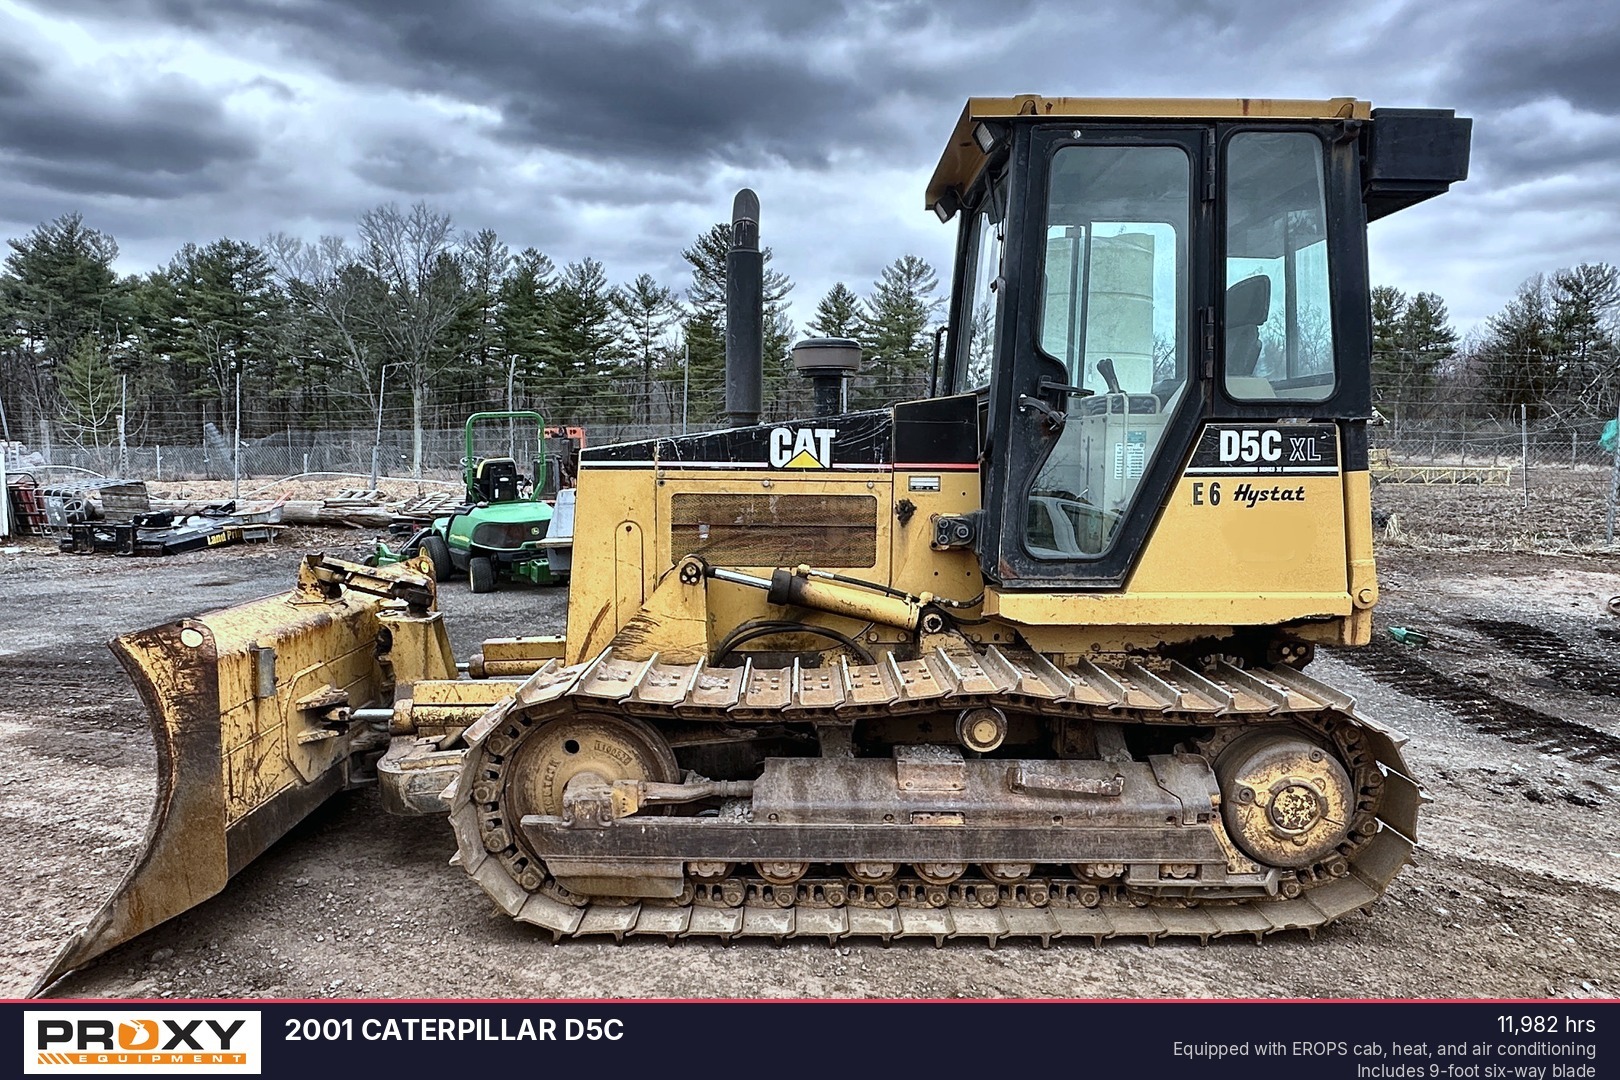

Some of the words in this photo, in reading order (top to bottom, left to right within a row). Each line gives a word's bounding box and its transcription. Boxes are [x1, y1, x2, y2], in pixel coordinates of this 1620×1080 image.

[770, 428, 836, 468] CAT
[1219, 430, 1282, 462] D5C
[1289, 437, 1322, 461] XL
[1193, 482, 1204, 505] E
[1209, 482, 1221, 506] 6
[1233, 483, 1305, 508] Hystat
[207, 531, 226, 546] Land
